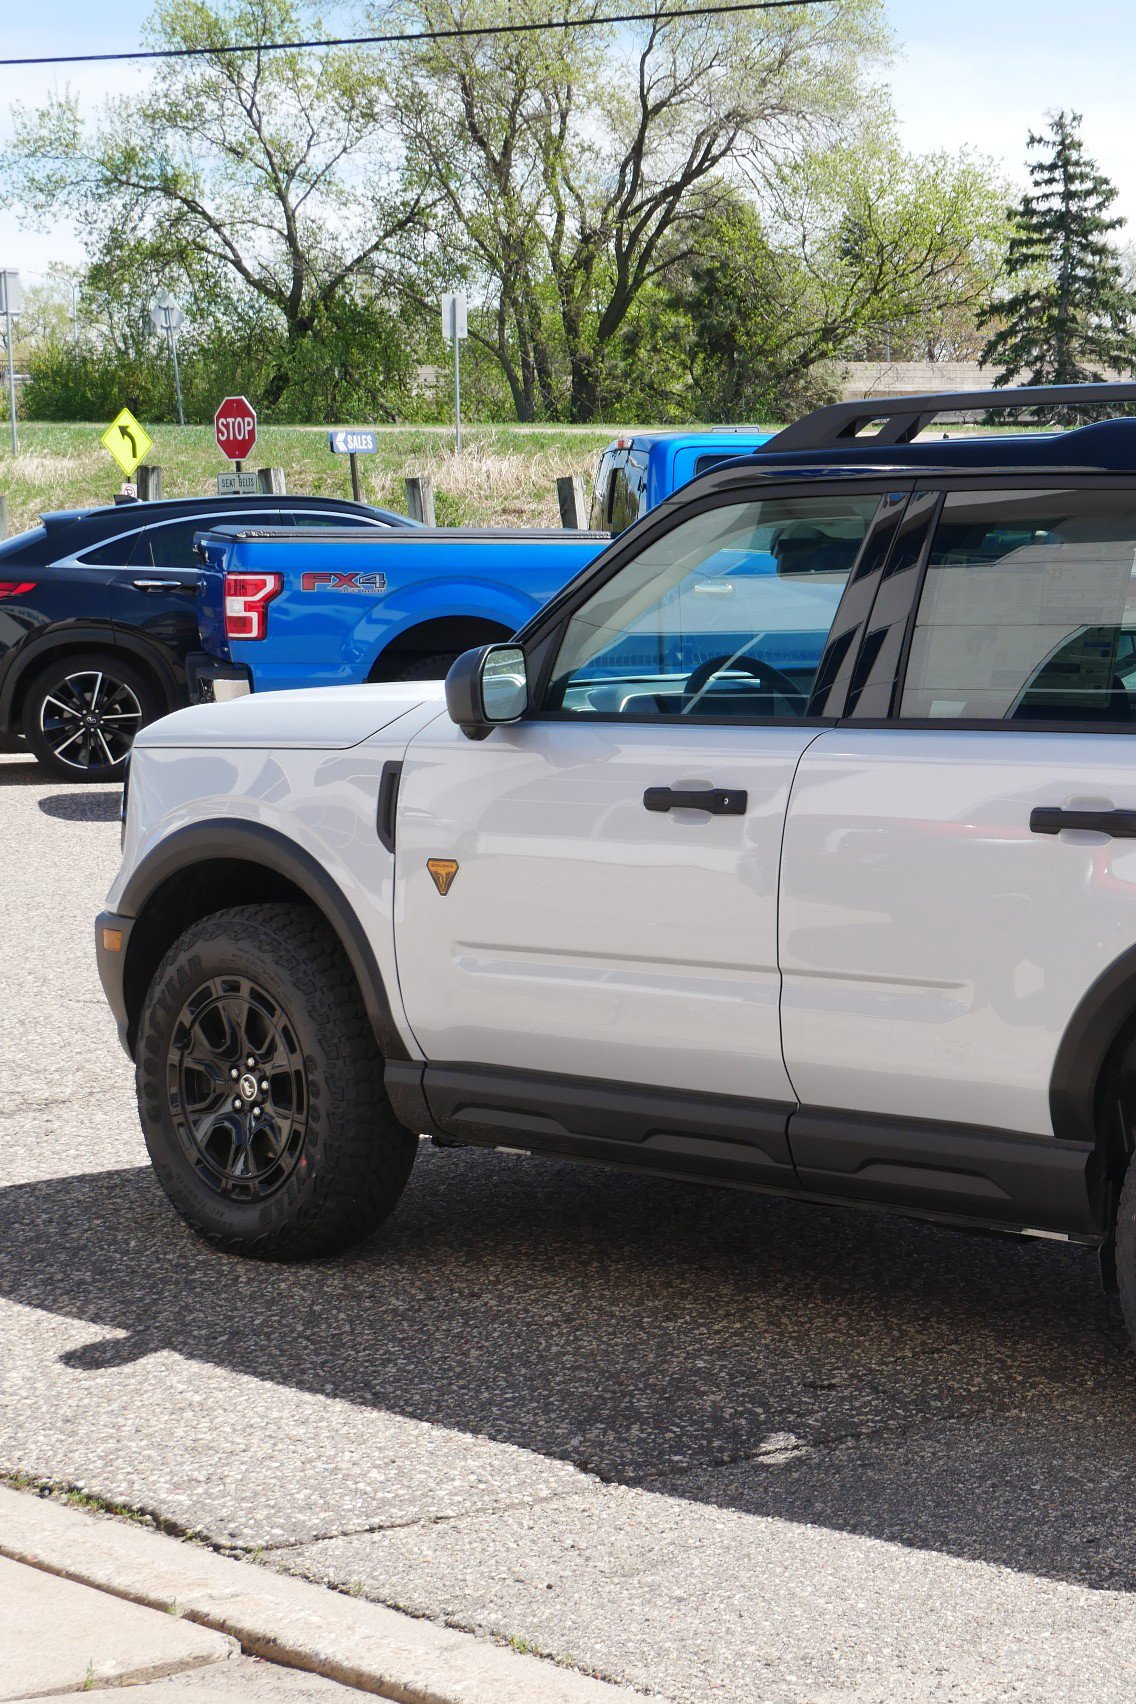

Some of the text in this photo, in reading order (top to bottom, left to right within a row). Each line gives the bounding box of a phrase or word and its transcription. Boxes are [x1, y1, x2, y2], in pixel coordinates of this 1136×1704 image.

[218, 417, 254, 441] STOP
[347, 434, 373, 450] SALES
[221, 477, 255, 488] SEAT BELTS
[301, 571, 388, 592] FX4
